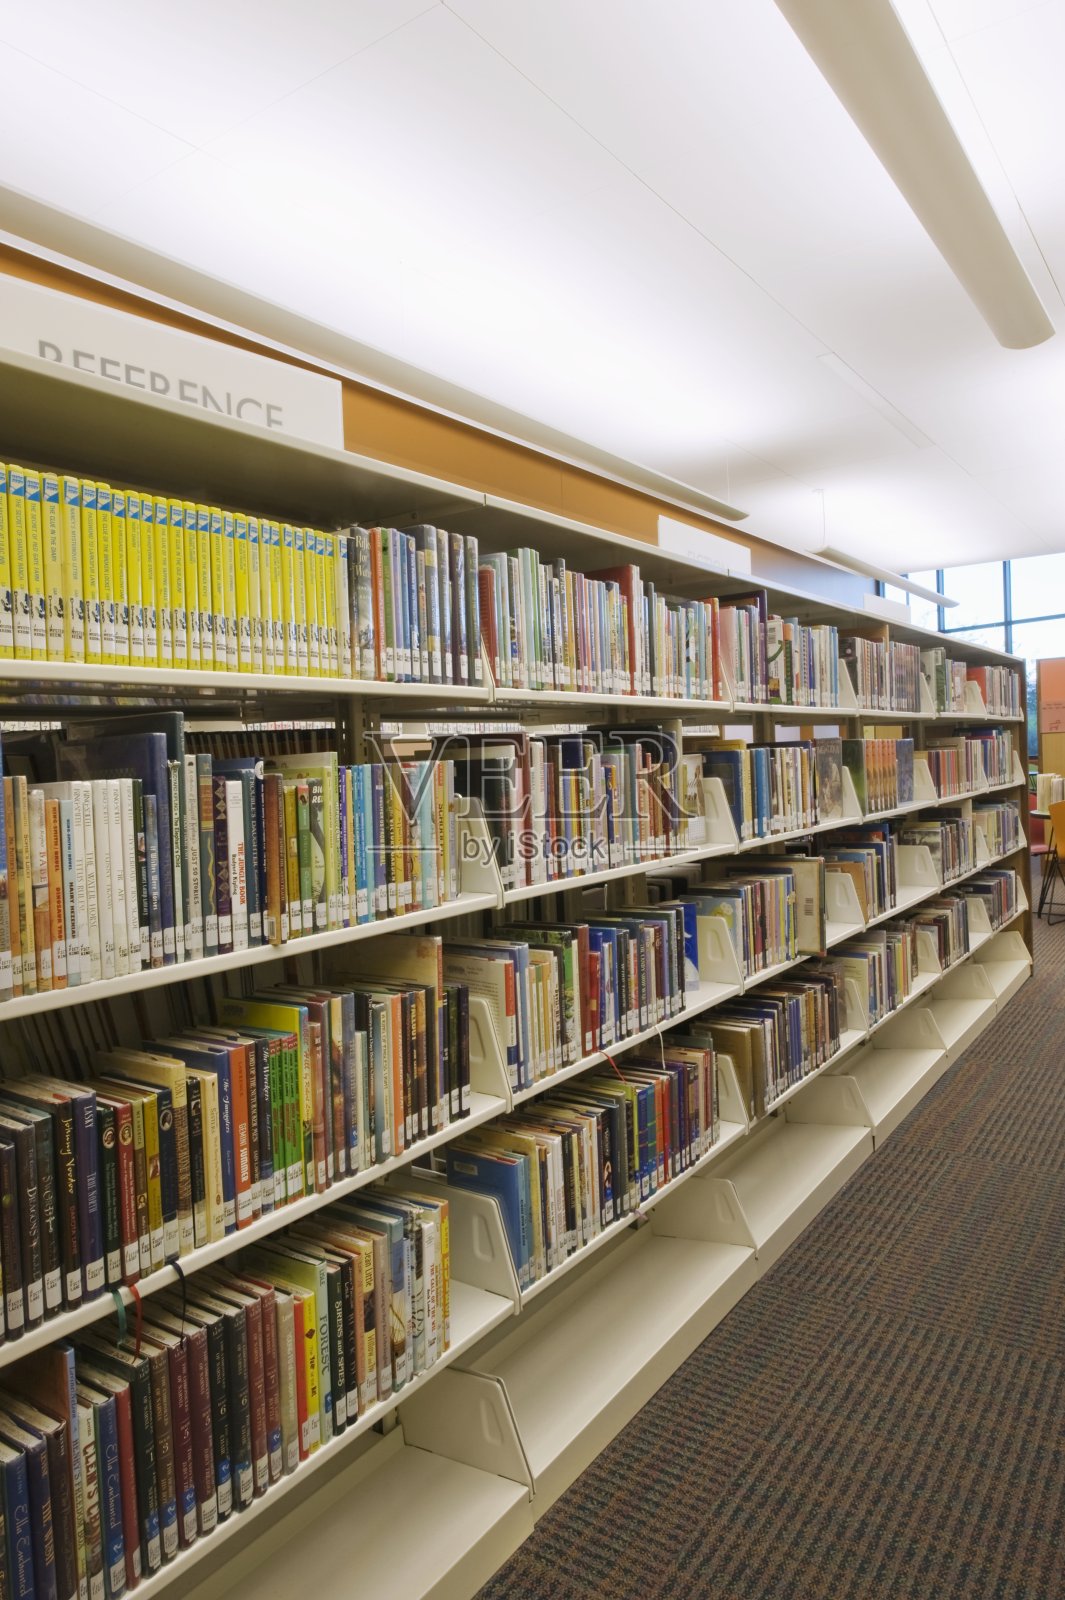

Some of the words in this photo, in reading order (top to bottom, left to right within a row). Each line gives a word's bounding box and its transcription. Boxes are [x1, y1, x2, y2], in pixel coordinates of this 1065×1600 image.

[39, 852, 48, 883] BABE
[192, 867, 198, 876] SO
[84, 1105, 93, 1128] LASKY
[62, 1118, 72, 1154] Johnny
[66, 1158, 75, 1194] Voodoo
[240, 1148, 248, 1182] SUMMER
[28, 1187, 38, 1235] DRAGONS
[365, 1252, 373, 1267] Jean
[365, 1269, 374, 1287] Little
[320, 1316, 329, 1375] FOREST
[156, 1388, 161, 1398] OF
[72, 1440, 81, 1478] HENRY'S
[84, 1440, 99, 1500] CLEM'S
[105, 1444, 117, 1471] Ella
[14, 1504, 28, 1534] Ella
[42, 1497, 51, 1526] THE
[74, 1481, 84, 1527] FREEDOM
[107, 1475, 120, 1529] Enchanted
[44, 1527, 54, 1566] WISH
[16, 1536, 33, 1596] Enchanted
